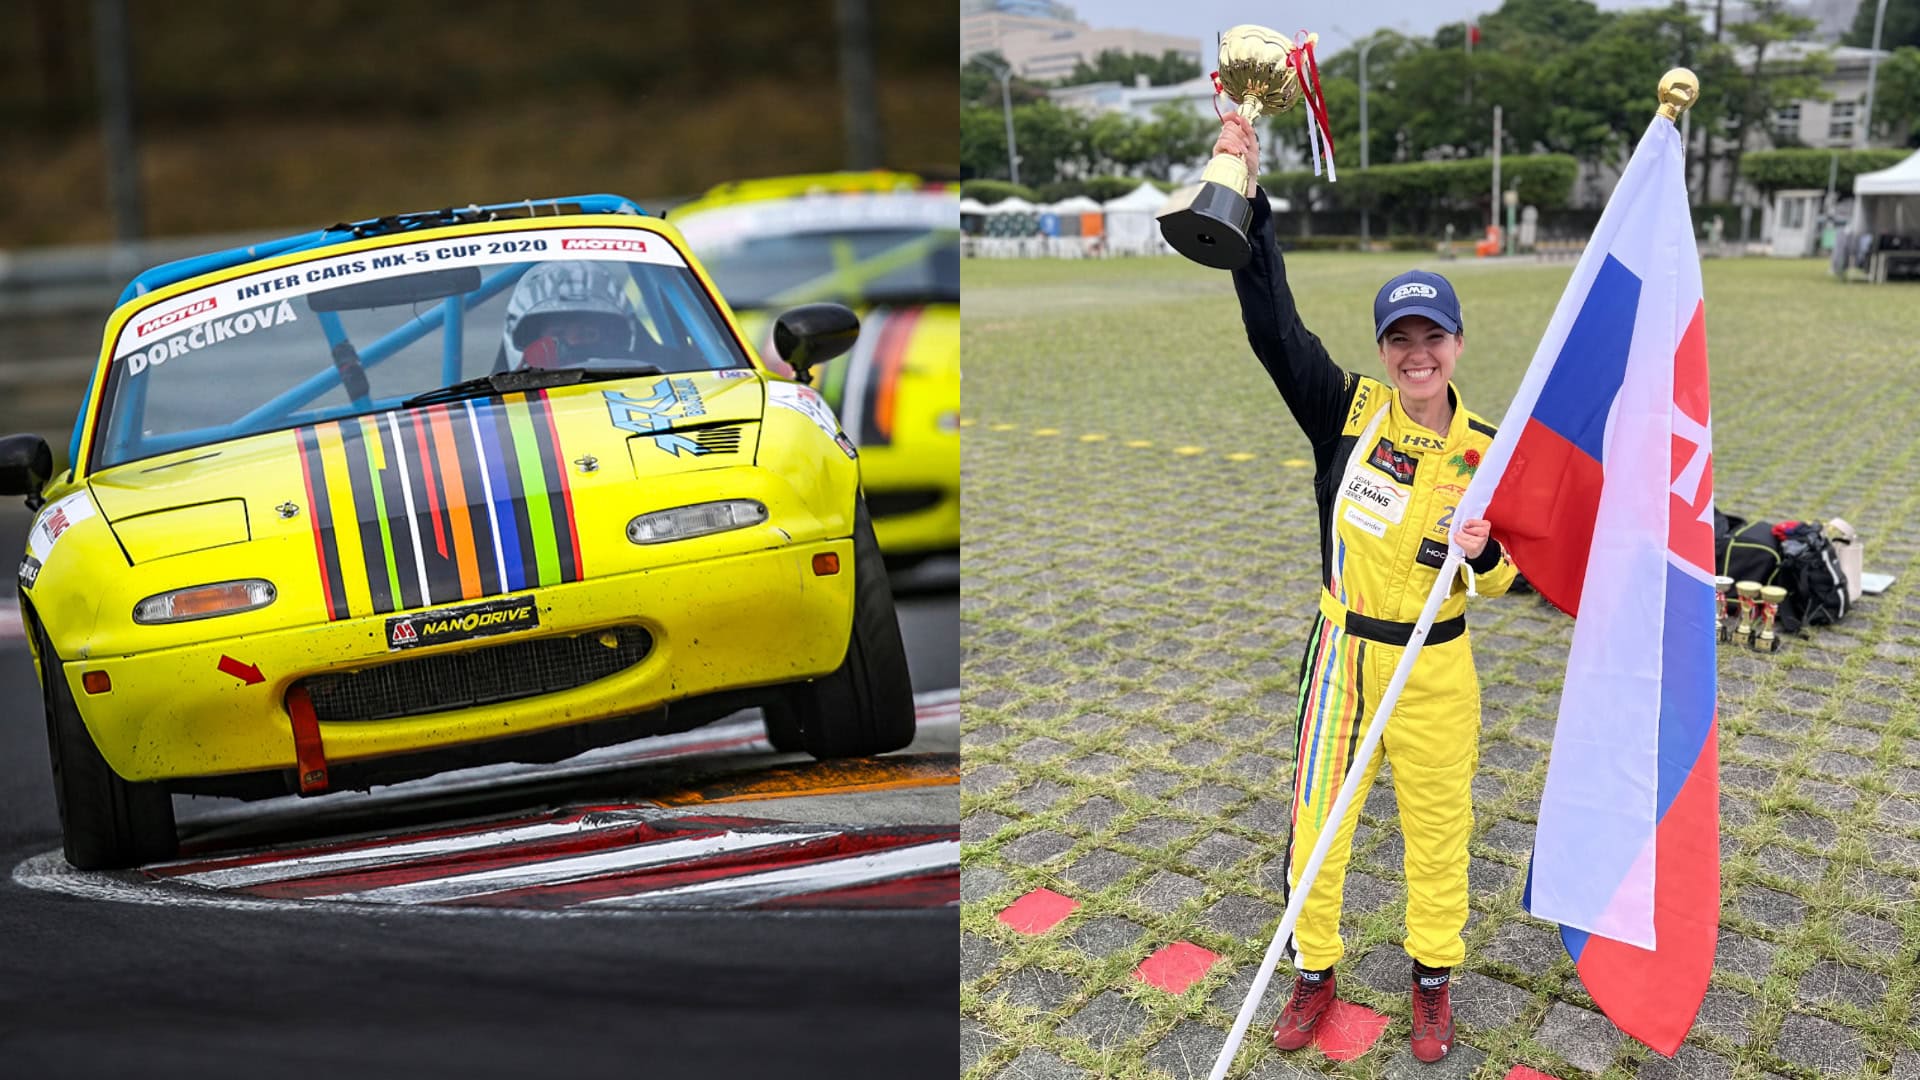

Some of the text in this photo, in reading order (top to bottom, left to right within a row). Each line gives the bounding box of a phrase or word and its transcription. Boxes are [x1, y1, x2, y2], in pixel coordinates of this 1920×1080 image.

[565, 239, 645, 253] MOTUL
[237, 238, 548, 301] INTER CARS MX-5 CUP 2020
[140, 297, 217, 336] MOTUL
[127, 300, 297, 376] DORČÍKOVÁ
[1349, 384, 1371, 427] HRX
[1402, 434, 1446, 450] HRX
[1348, 481, 1391, 507] LE MANS
[423, 606, 532, 636] NANODRIVE
